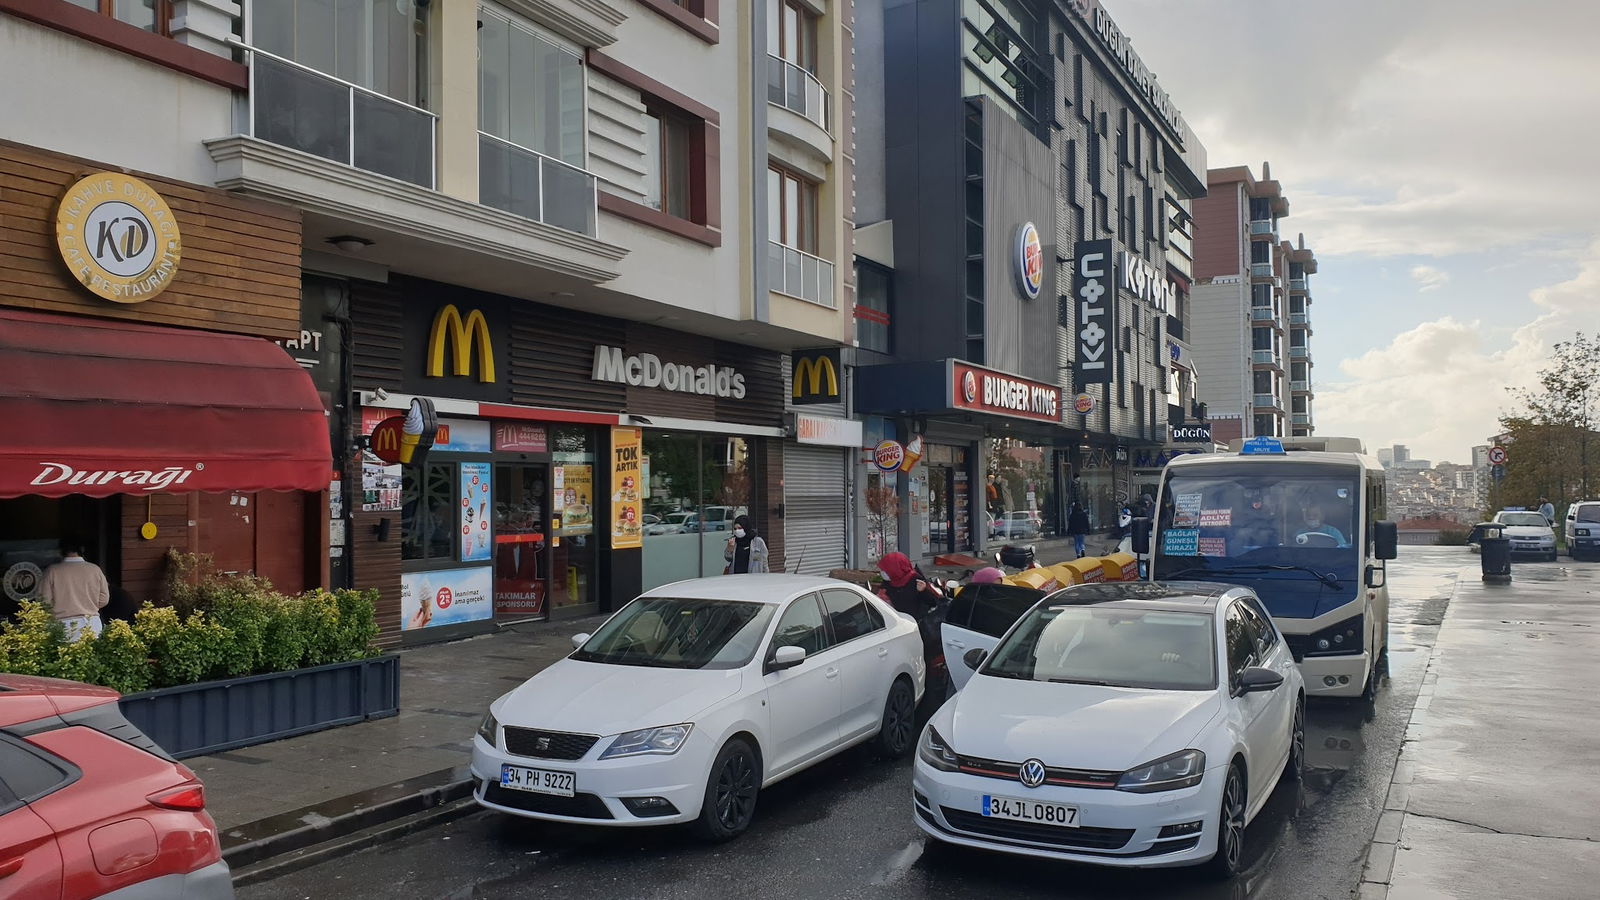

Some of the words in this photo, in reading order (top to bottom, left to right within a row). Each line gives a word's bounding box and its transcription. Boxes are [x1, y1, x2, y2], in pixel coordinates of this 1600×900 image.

[65, 180, 114, 218] KAHVE
[123, 183, 175, 238] DURAĞI
[97, 216, 149, 262] KD
[64, 235, 92, 277] CAFE
[93, 251, 177, 296] RESTAURANT
[592, 345, 746, 399] McDonald's
[983, 375, 1030, 412] BURGER
[1030, 386, 1057, 416] KING
[1174, 427, 1210, 439] DÜĞÜN
[615, 446, 637, 462] TOK
[876, 445, 900, 457] BURGER
[876, 451, 900, 464] KING
[30, 462, 193, 491] Durağı
[616, 461, 638, 473] ARTIK
[496, 600, 536, 608] SPONSORU
[509, 768, 520, 784] 34
[526, 770, 540, 786] PH
[544, 772, 572, 791] 9222
